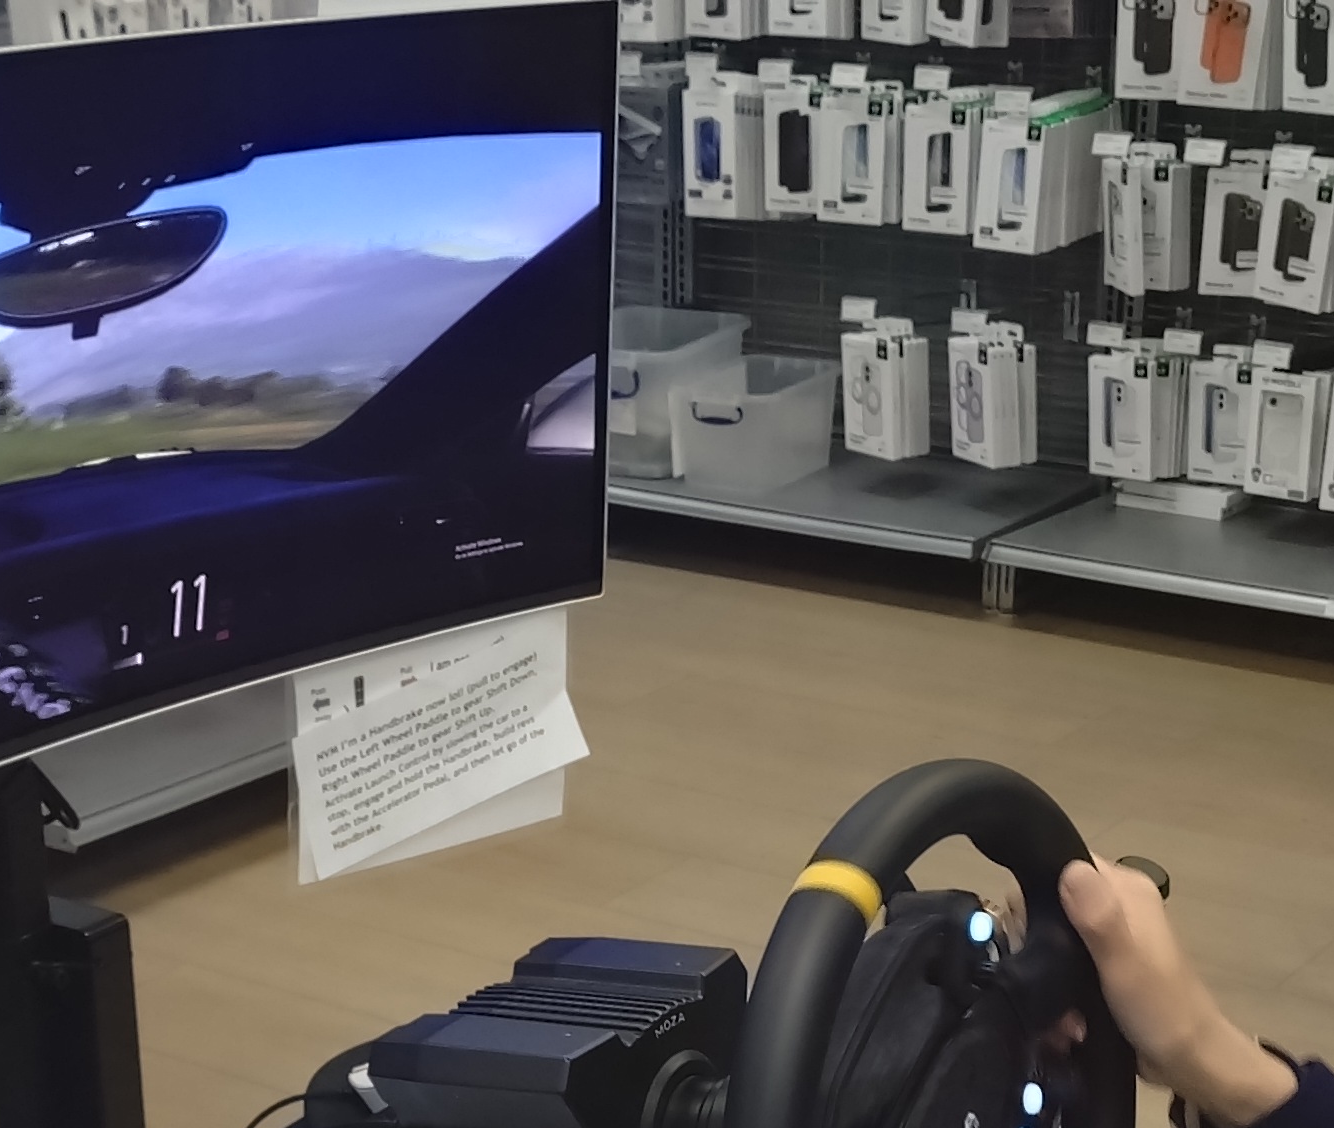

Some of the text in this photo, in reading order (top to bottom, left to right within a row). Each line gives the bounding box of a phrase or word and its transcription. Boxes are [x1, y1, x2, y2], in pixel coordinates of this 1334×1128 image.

[170, 573, 207, 638] 11
[318, 763, 338, 778] Use
[340, 754, 357, 768] the
[359, 742, 380, 759] Left
[382, 726, 414, 746] Wheel
[415, 712, 449, 733] Paddle
[450, 706, 462, 717] to
[486, 682, 508, 699] Shift
[321, 774, 349, 793] Right
[350, 757, 382, 779] Wheel
[383, 743, 417, 764] Paddle
[417, 737, 430, 748] to
[454, 713, 477, 731] Shift
[369, 708, 424, 738] Handbrake
[325, 786, 364, 808] Activate
[364, 768, 397, 790] Launch
[398, 751, 431, 773] Control
[479, 721, 494, 733] the
[353, 813, 370, 827] the
[372, 787, 421, 819] Accelerator
[453, 763, 470, 778] and
[529, 728, 546, 740] the
[387, 779, 404, 795] and
[403, 768, 424, 786] hold
[425, 762, 441, 775] the
[653, 1012, 686, 1040] MOZA
